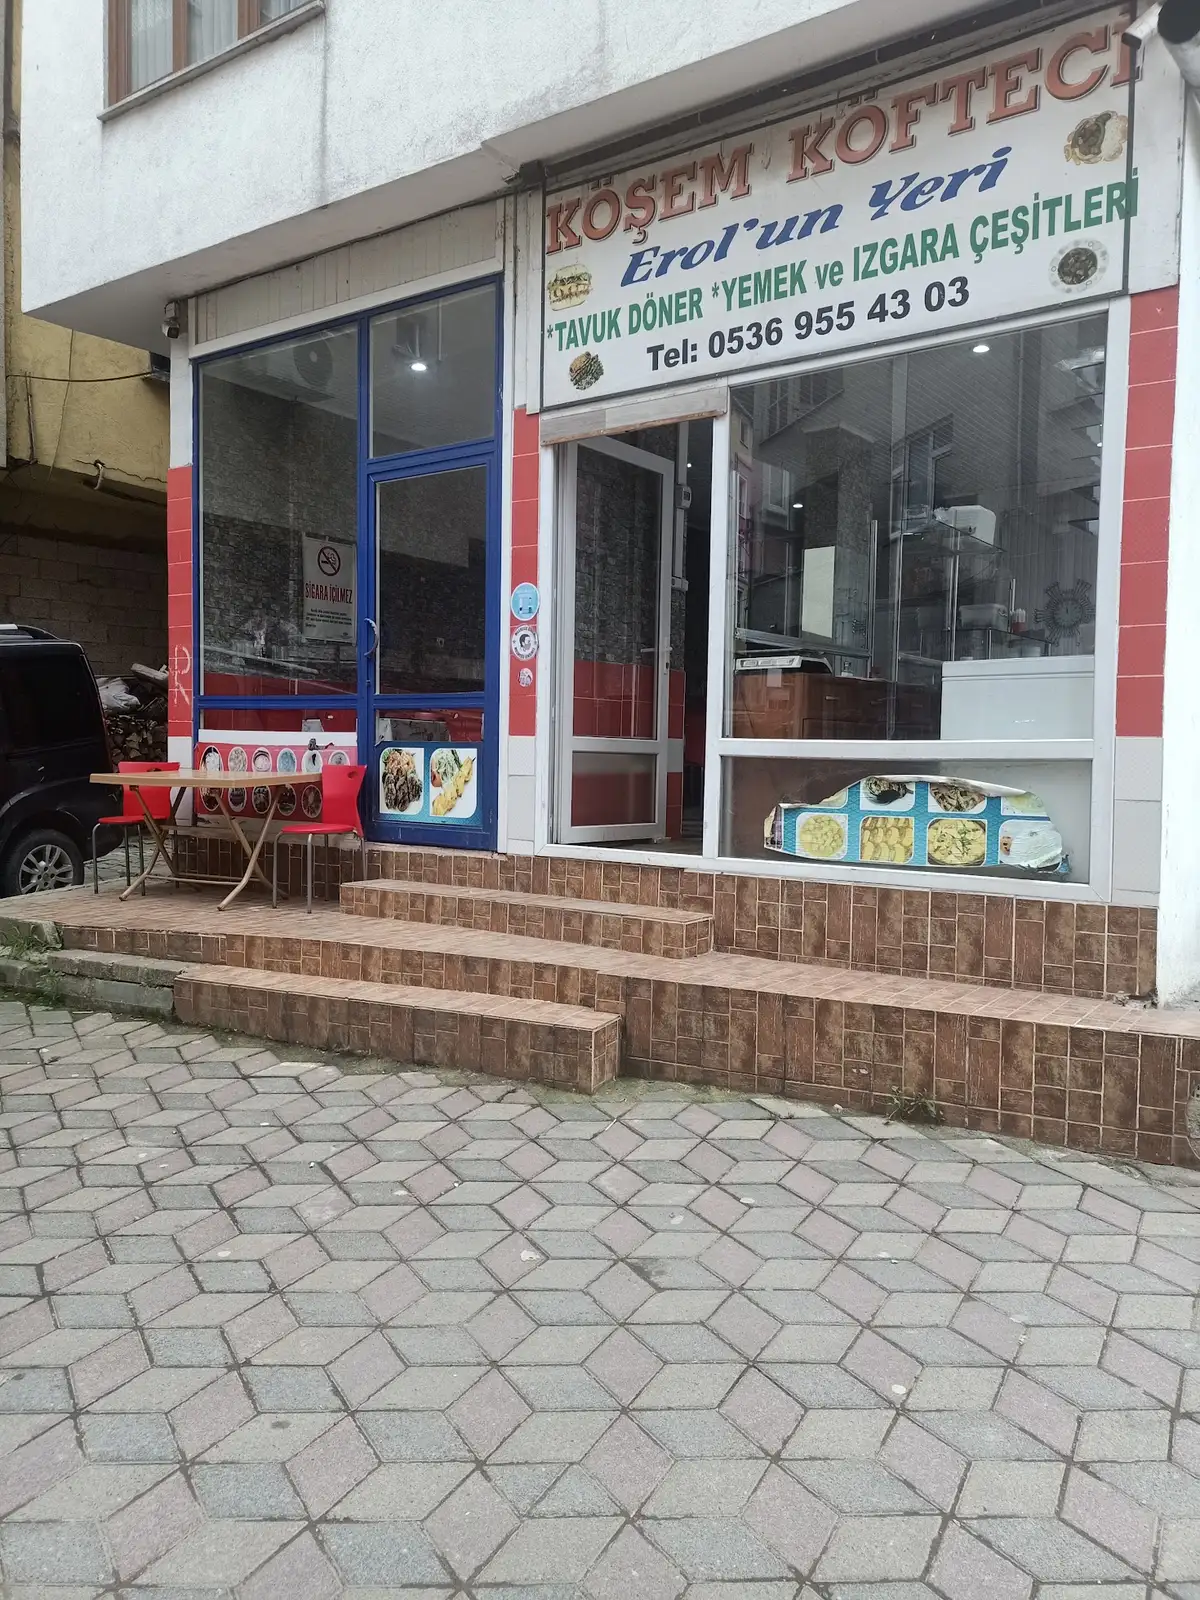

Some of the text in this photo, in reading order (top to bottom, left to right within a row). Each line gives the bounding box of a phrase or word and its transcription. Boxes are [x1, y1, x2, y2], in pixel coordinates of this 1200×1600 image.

[545, 143, 754, 256] KÖŞEM
[869, 147, 1012, 221] Yeri
[628, 287, 703, 335] DÖNER
[815, 260, 844, 290] ve
[853, 223, 959, 282] IZGARA
[969, 168, 1139, 264] ÇEŞİTLERİ
[646, 276, 970, 371] Tel: 0536 955 43 03
[305, 581, 353, 604] SİGARA İÇİLMEZ
